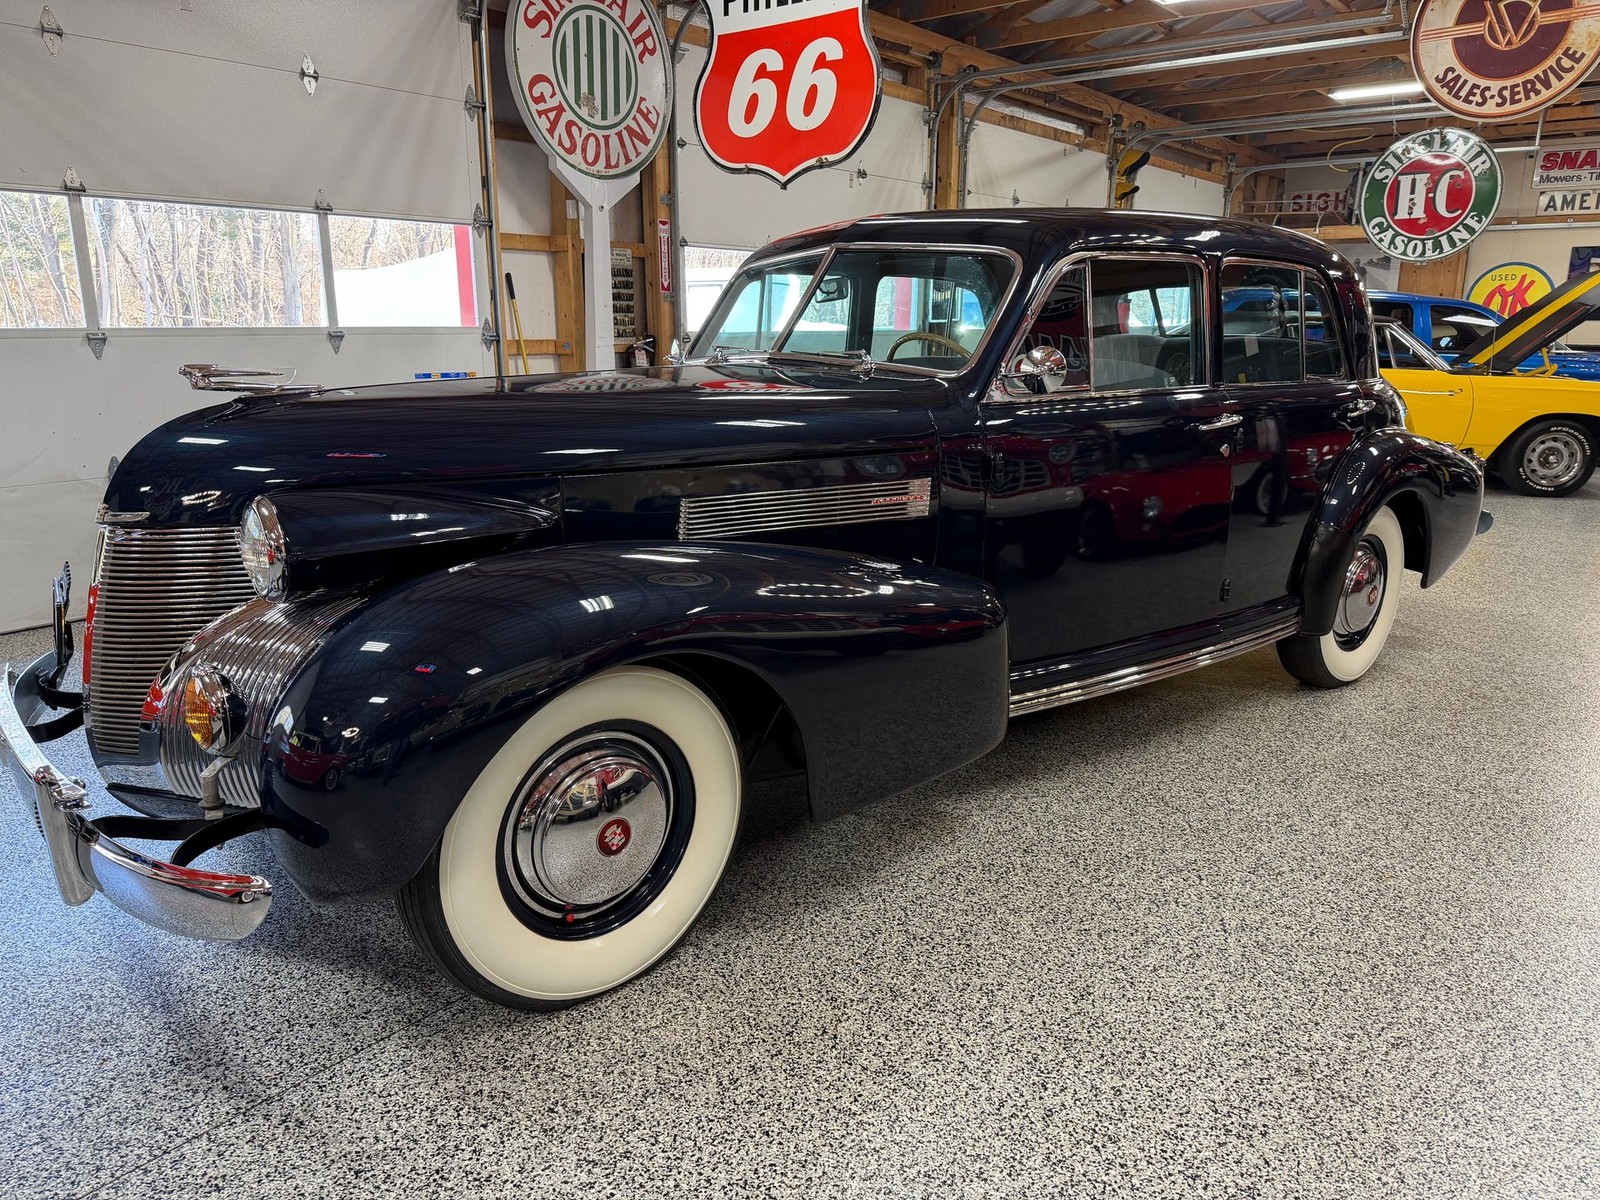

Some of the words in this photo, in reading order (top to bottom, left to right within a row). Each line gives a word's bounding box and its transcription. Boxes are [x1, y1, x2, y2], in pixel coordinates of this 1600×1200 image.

[523, 0, 657, 64] SIAIR
[727, 36, 844, 138] 66
[1434, 46, 1586, 108] SALES-SERVICE
[528, 73, 660, 170] GASOLINE
[1373, 132, 1491, 183] SINCLAIR
[1539, 174, 1582, 184] Mowers
[1540, 150, 1600, 171] SNA
[1368, 211, 1487, 258] GASOLINE
[1482, 273, 1536, 317] OK
[1491, 273, 1517, 282] USED
